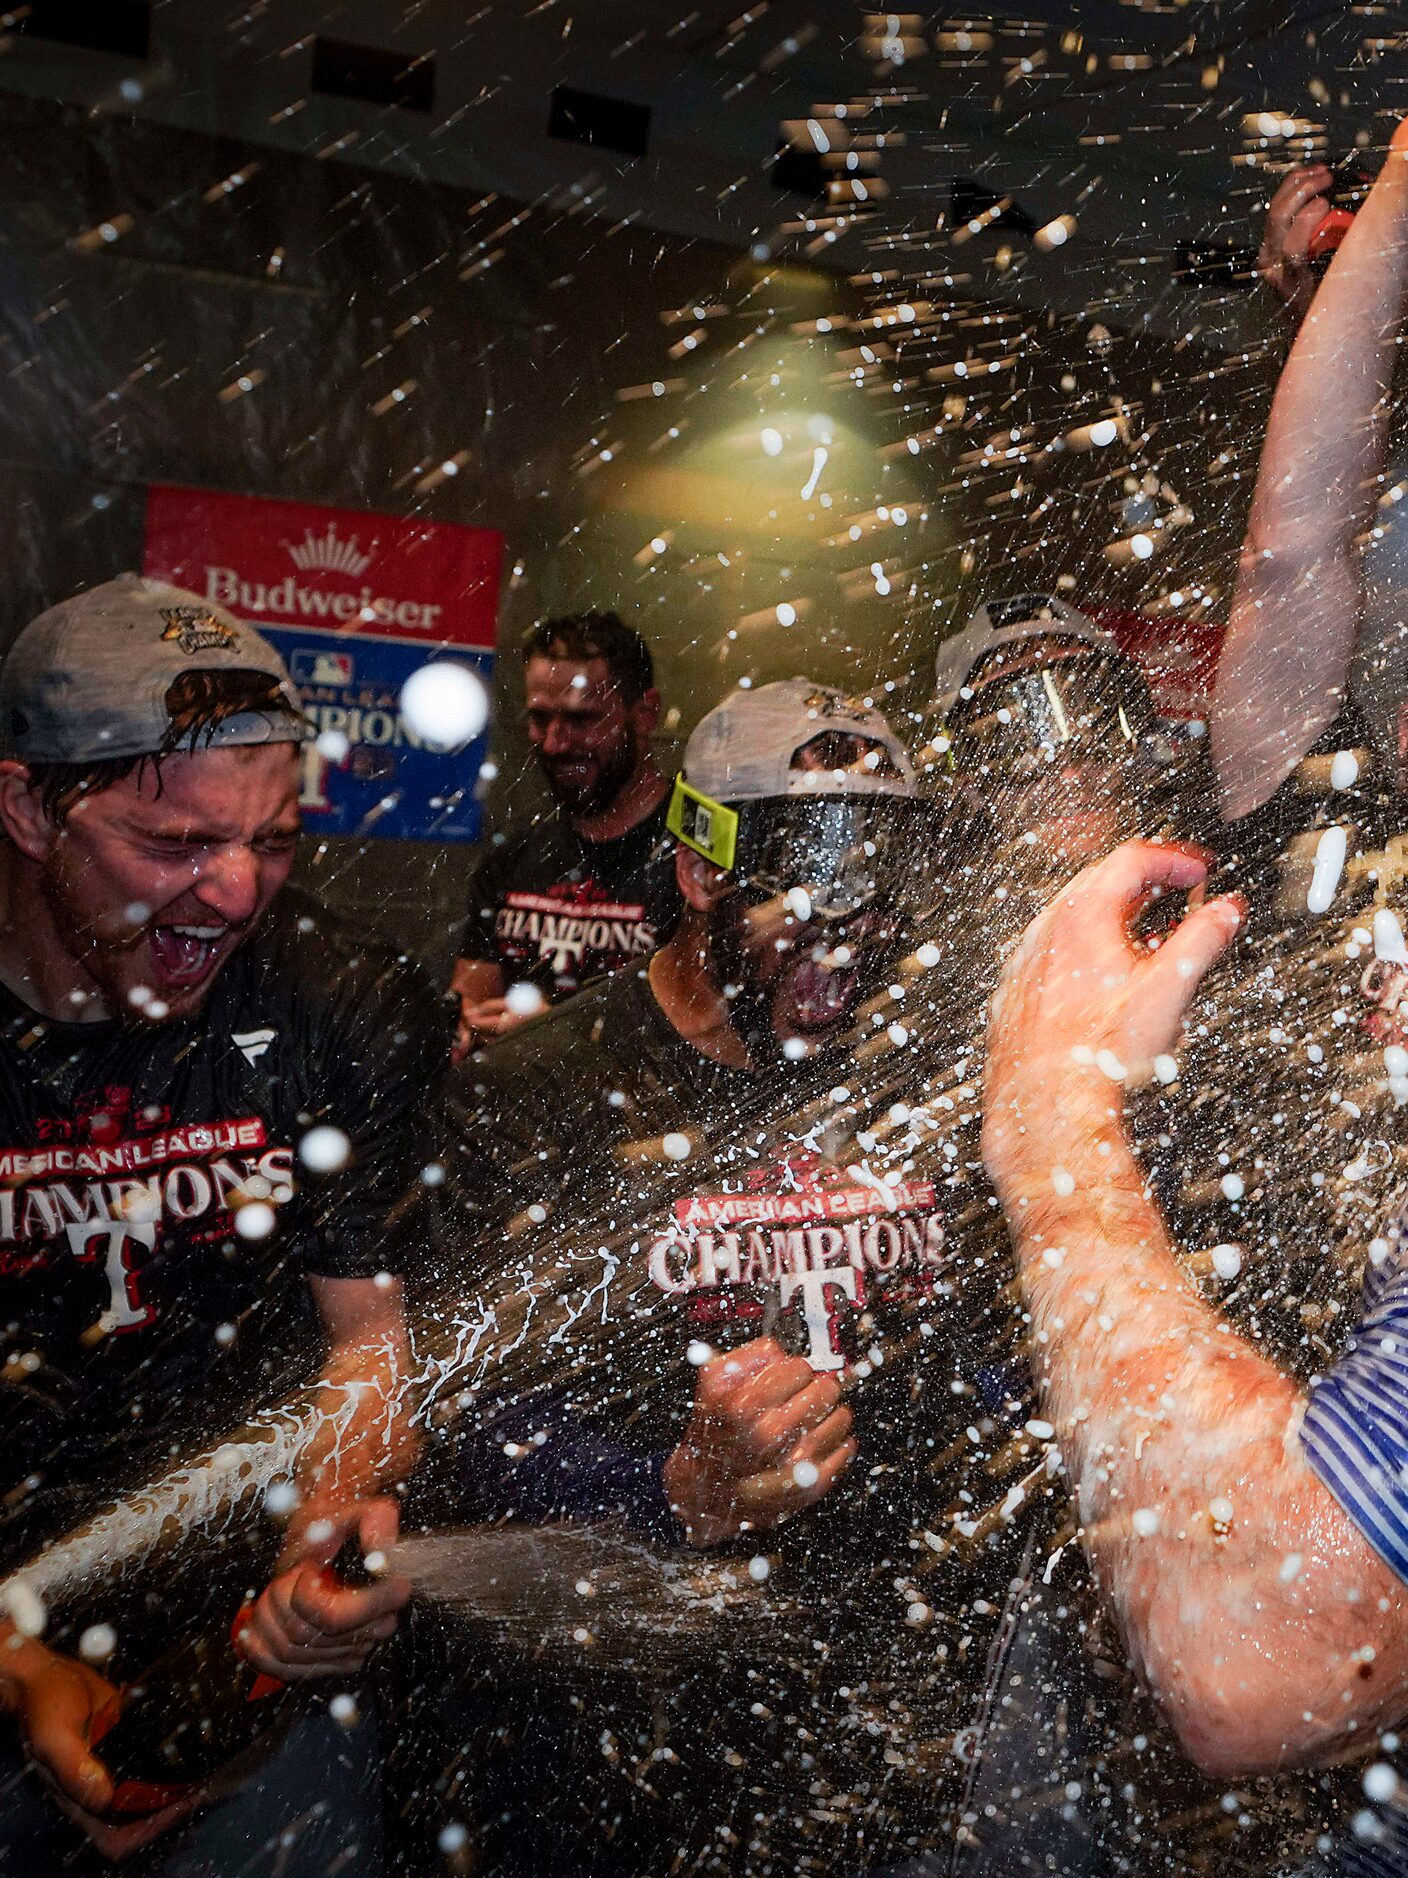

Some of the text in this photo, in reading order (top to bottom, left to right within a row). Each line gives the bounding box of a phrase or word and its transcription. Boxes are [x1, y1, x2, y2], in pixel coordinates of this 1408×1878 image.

[204, 565, 443, 630] Budweiser
[0, 1121, 260, 1175] MERICAN LEAGUE
[65, 1218, 156, 1328] T
[648, 1213, 945, 1293] CHAMPIONS
[780, 1266, 858, 1372] T
